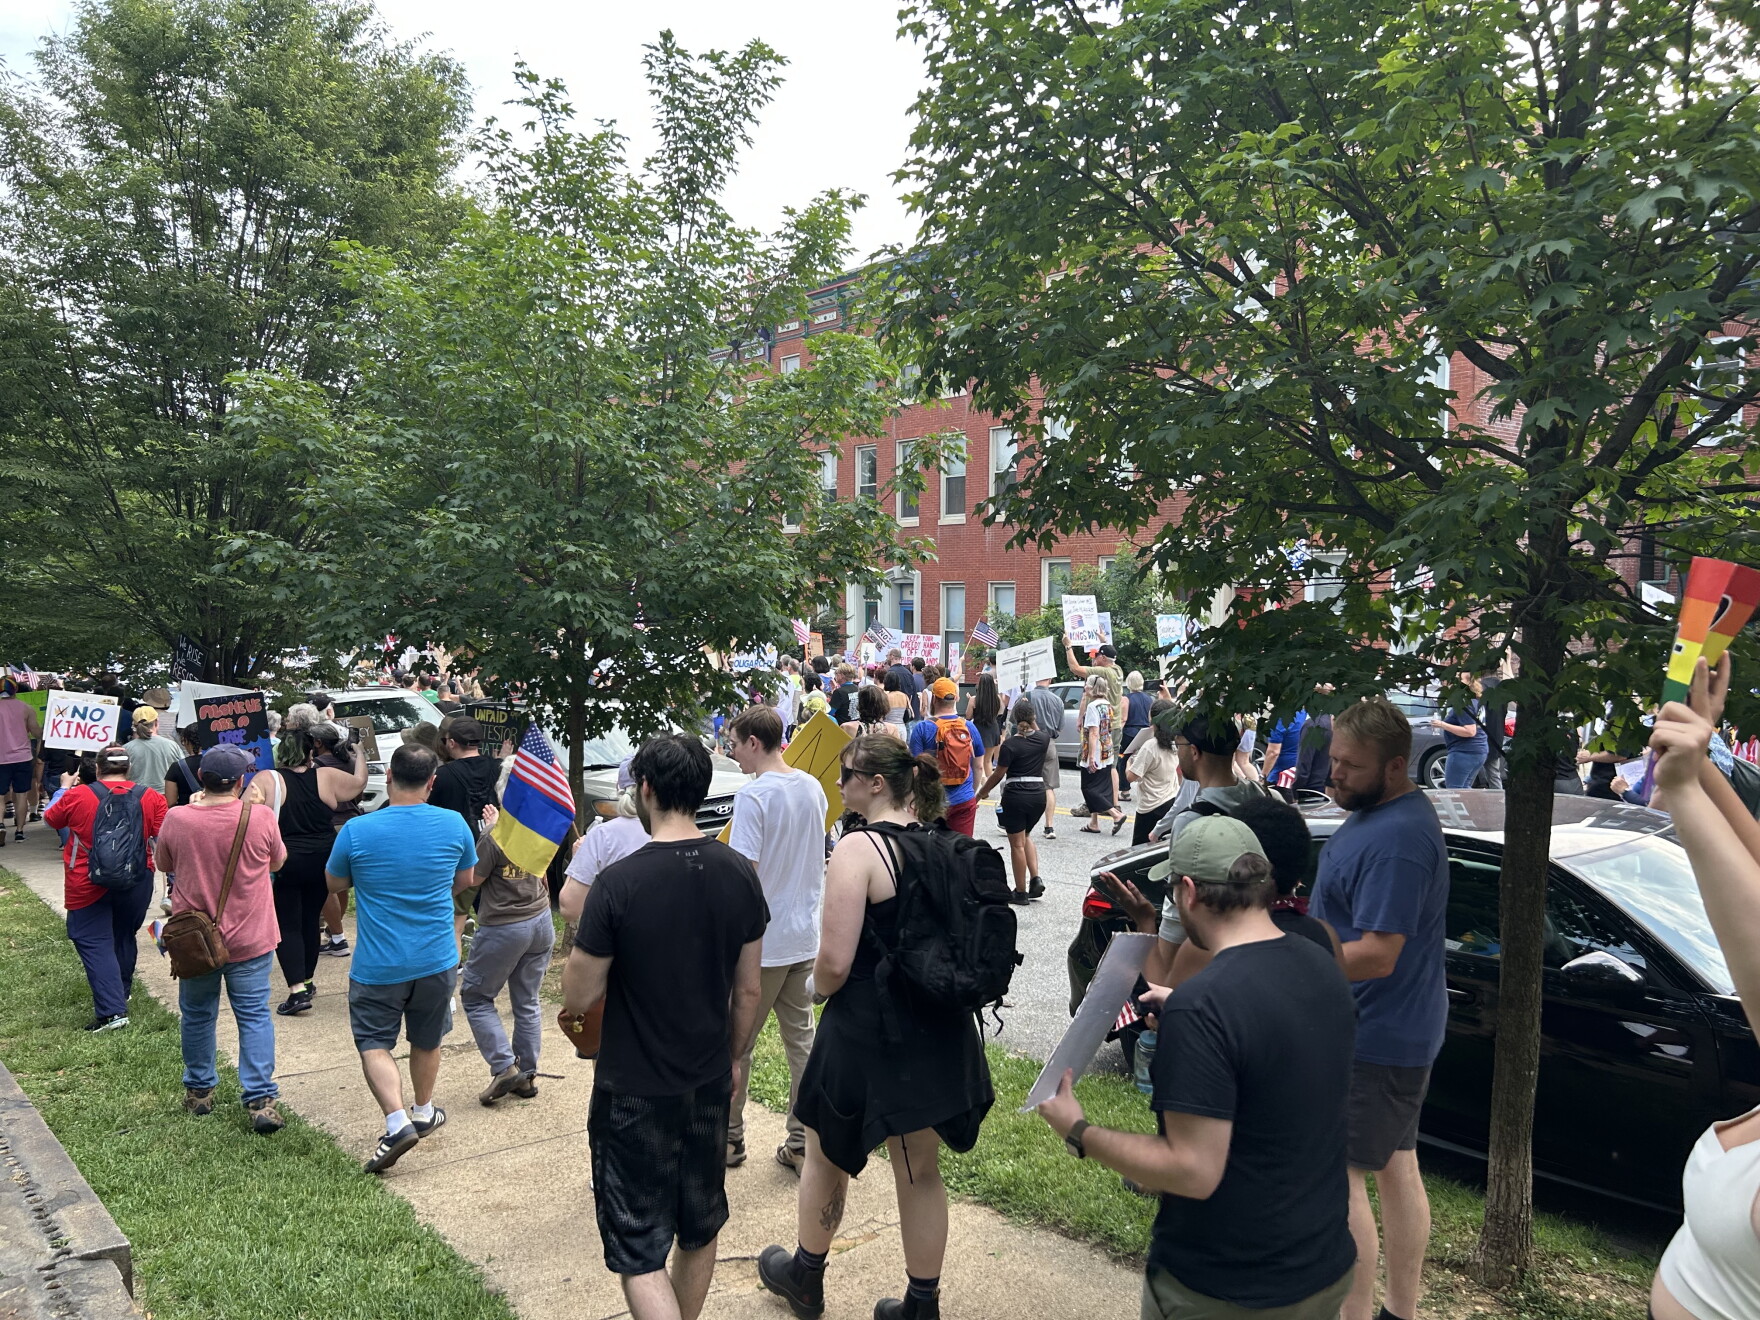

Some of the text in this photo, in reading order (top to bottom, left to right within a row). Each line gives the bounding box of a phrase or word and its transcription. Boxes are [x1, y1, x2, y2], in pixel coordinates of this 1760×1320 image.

[186, 644, 204, 665] RISE
[71, 705, 106, 723] NO
[199, 698, 262, 720] ALONE WE
[474, 707, 508, 724] UNPAID
[50, 718, 112, 742] KINGS
[210, 715, 250, 732] ARE A
